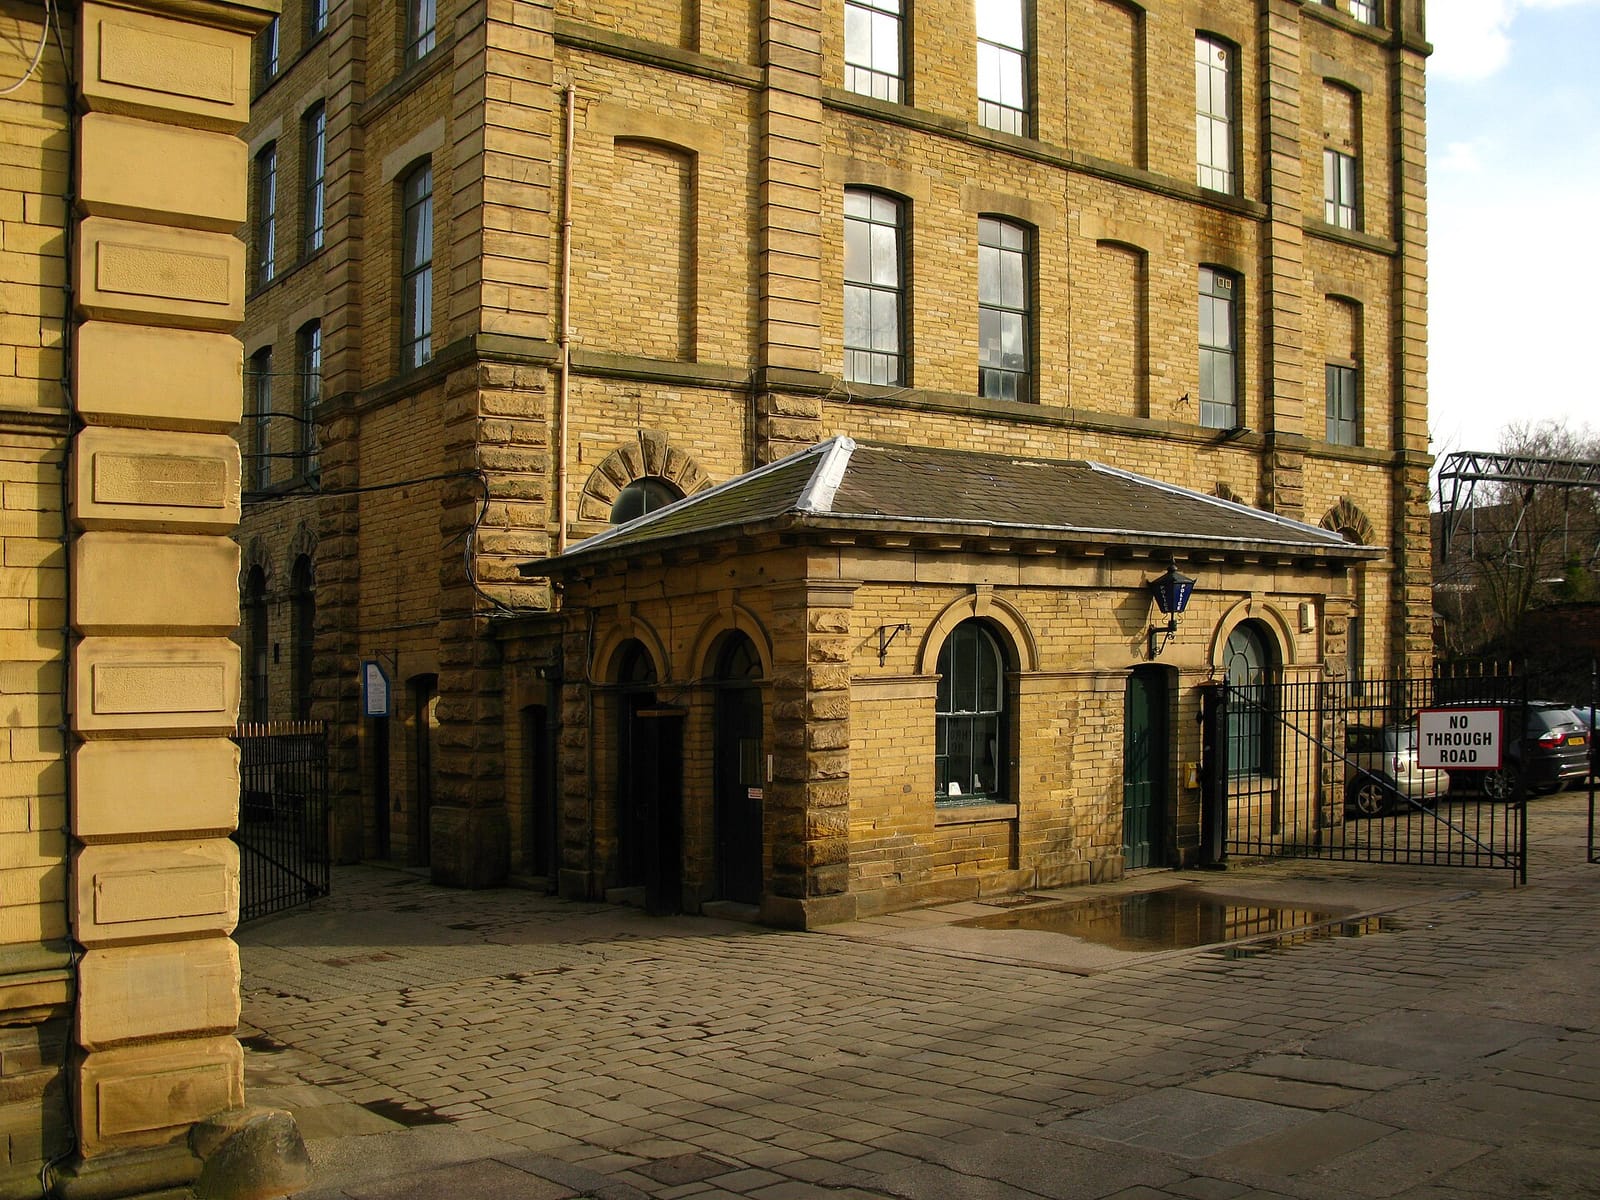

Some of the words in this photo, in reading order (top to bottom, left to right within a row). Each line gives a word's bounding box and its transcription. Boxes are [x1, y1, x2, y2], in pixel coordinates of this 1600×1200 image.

[1176, 583, 1186, 610] POLICE
[1449, 715, 1468, 729] NO
[1426, 732, 1492, 746] THROUGH
[1440, 749, 1477, 763] ROAD
